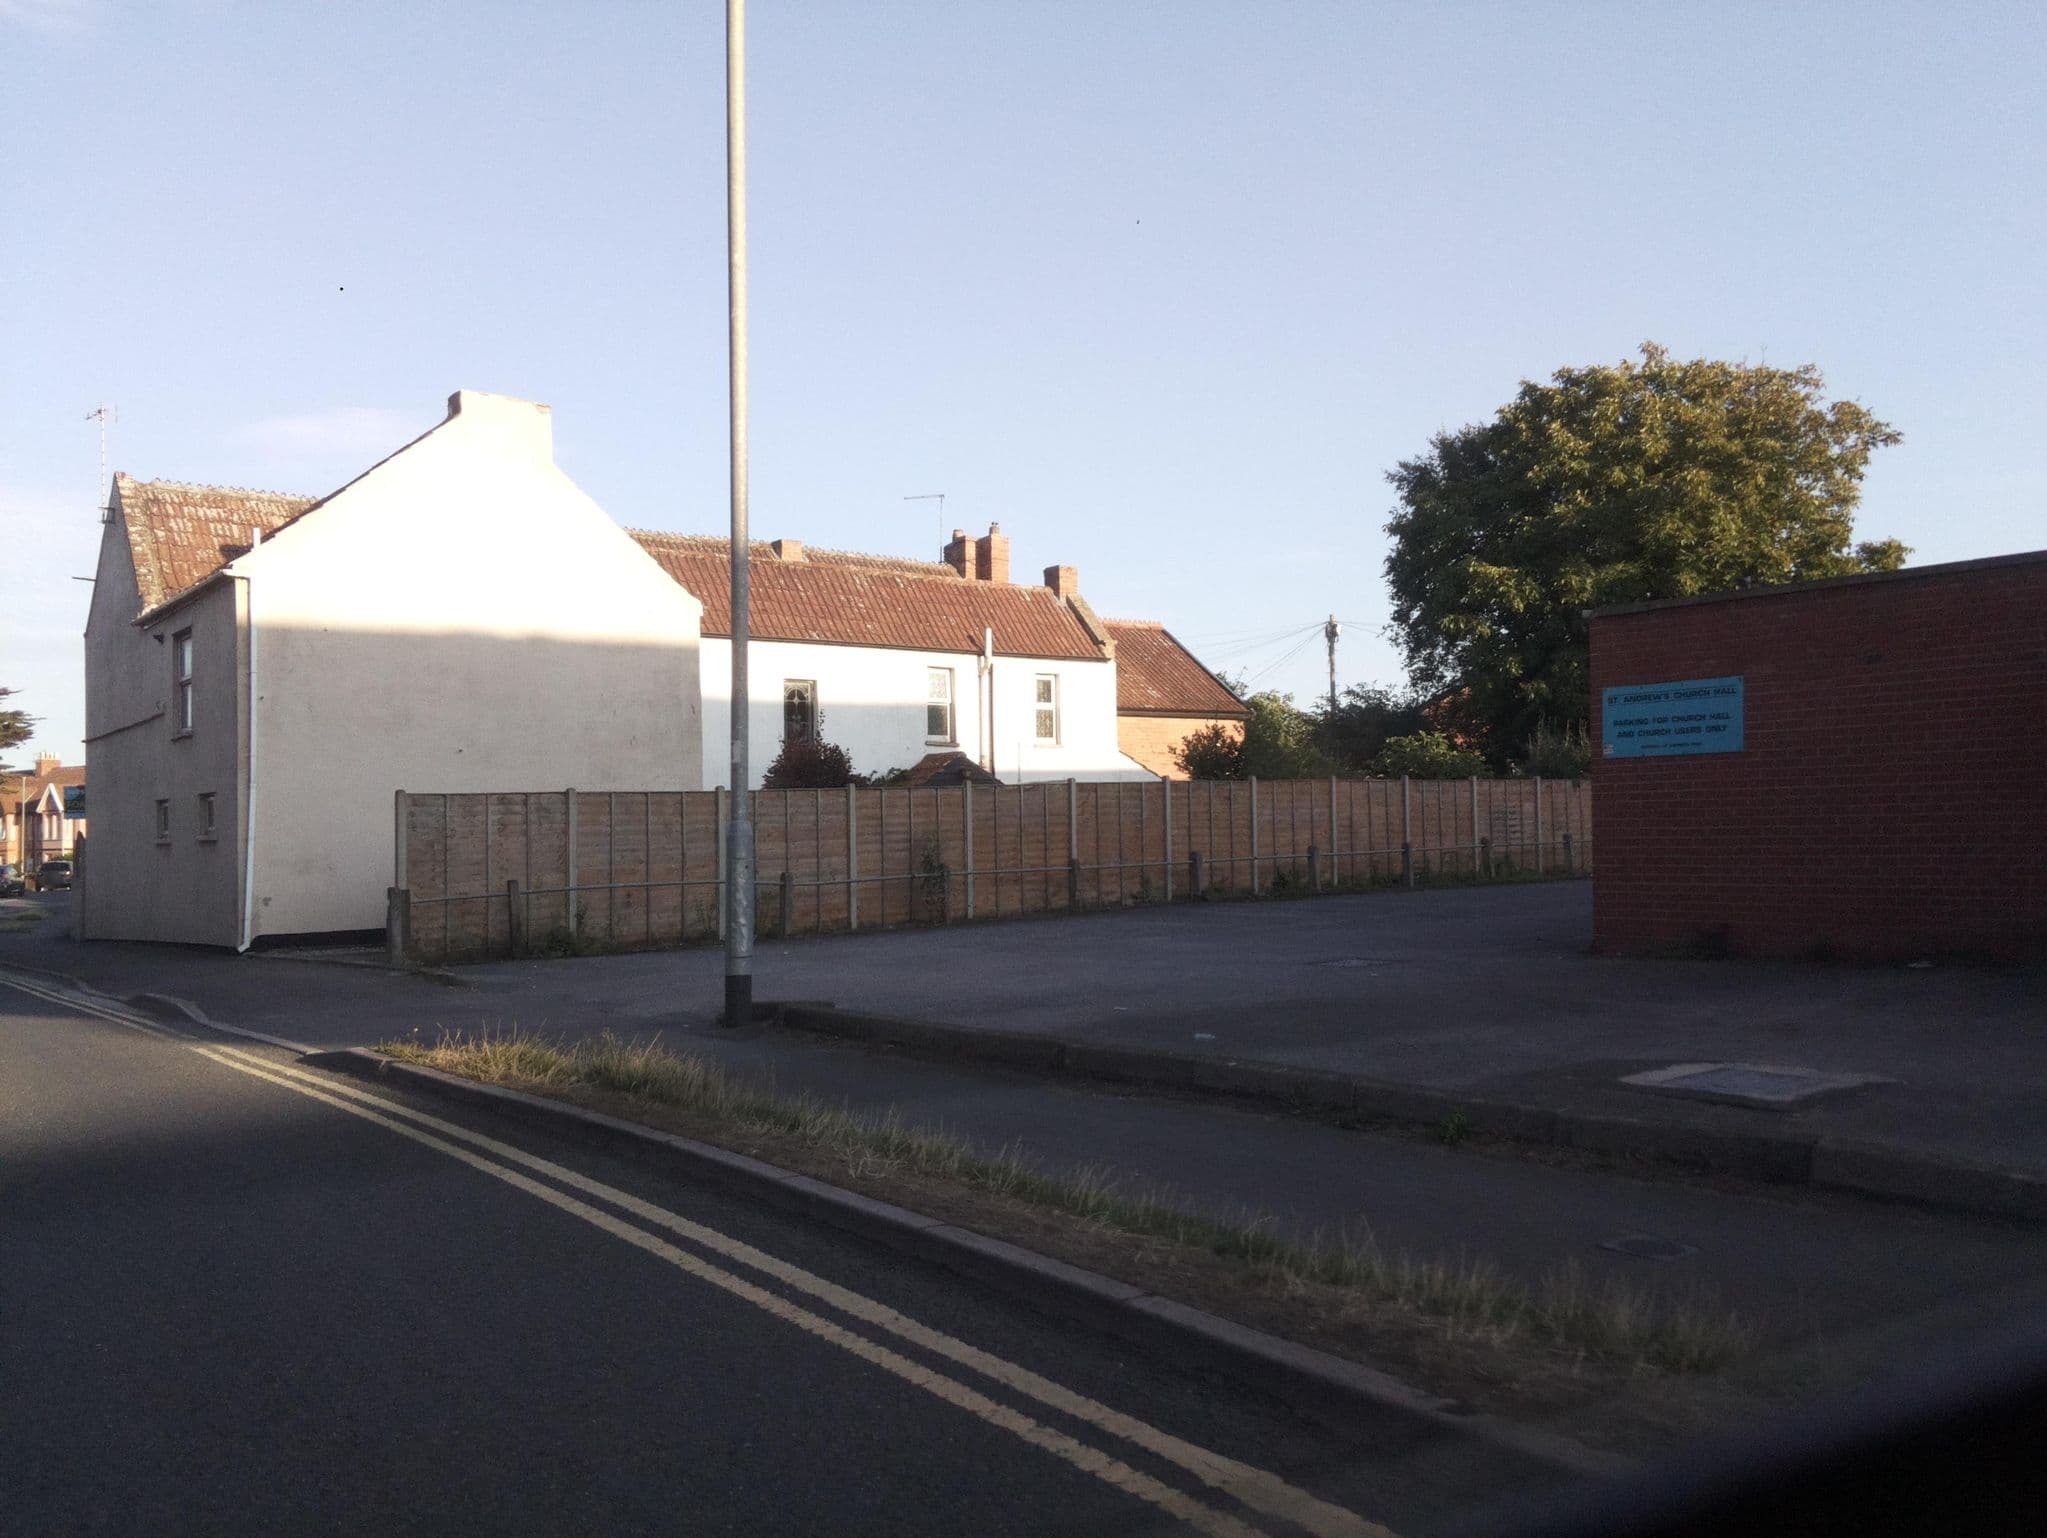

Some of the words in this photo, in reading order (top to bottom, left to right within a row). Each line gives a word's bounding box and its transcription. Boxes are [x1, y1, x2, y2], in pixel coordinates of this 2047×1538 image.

[1623, 692, 1670, 703] ANDREW'S
[1672, 690, 1711, 699] CHURCH
[1713, 687, 1737, 696] HALL
[1613, 717, 1649, 726] PARKING
[1652, 716, 1668, 724] FOR
[1671, 713, 1706, 723] CHURCH
[1709, 711, 1731, 720] HALL
[1616, 730, 1635, 738] AND
[1638, 728, 1671, 737] CHURCH
[1673, 726, 1703, 735] USERS
[1705, 724, 1728, 732] ONLY
